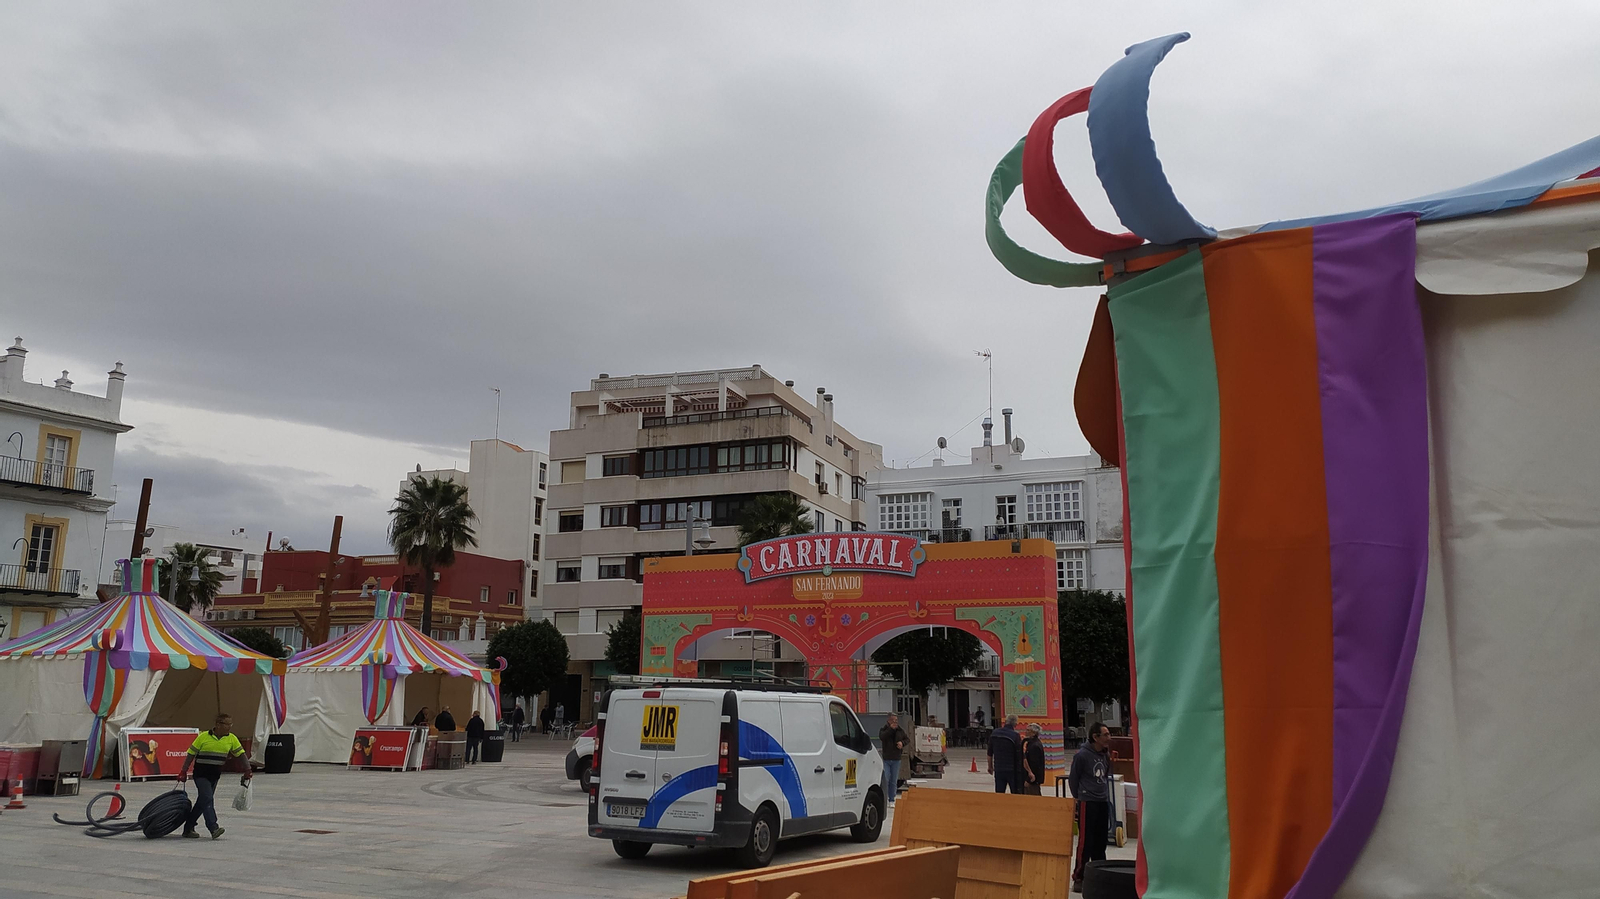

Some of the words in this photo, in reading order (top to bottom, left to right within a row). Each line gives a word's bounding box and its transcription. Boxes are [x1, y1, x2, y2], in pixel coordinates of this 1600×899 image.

[759, 537, 903, 573] CARNAVAL
[796, 577, 813, 591] SAN
[815, 576, 861, 591] FERNANDO
[821, 592, 834, 600] 2023
[643, 706, 677, 738] JMR
[380, 744, 404, 752] Cruzcampo
[846, 759, 857, 780] JMR
[611, 805, 628, 815] 9018
[630, 806, 644, 816] LFZ
